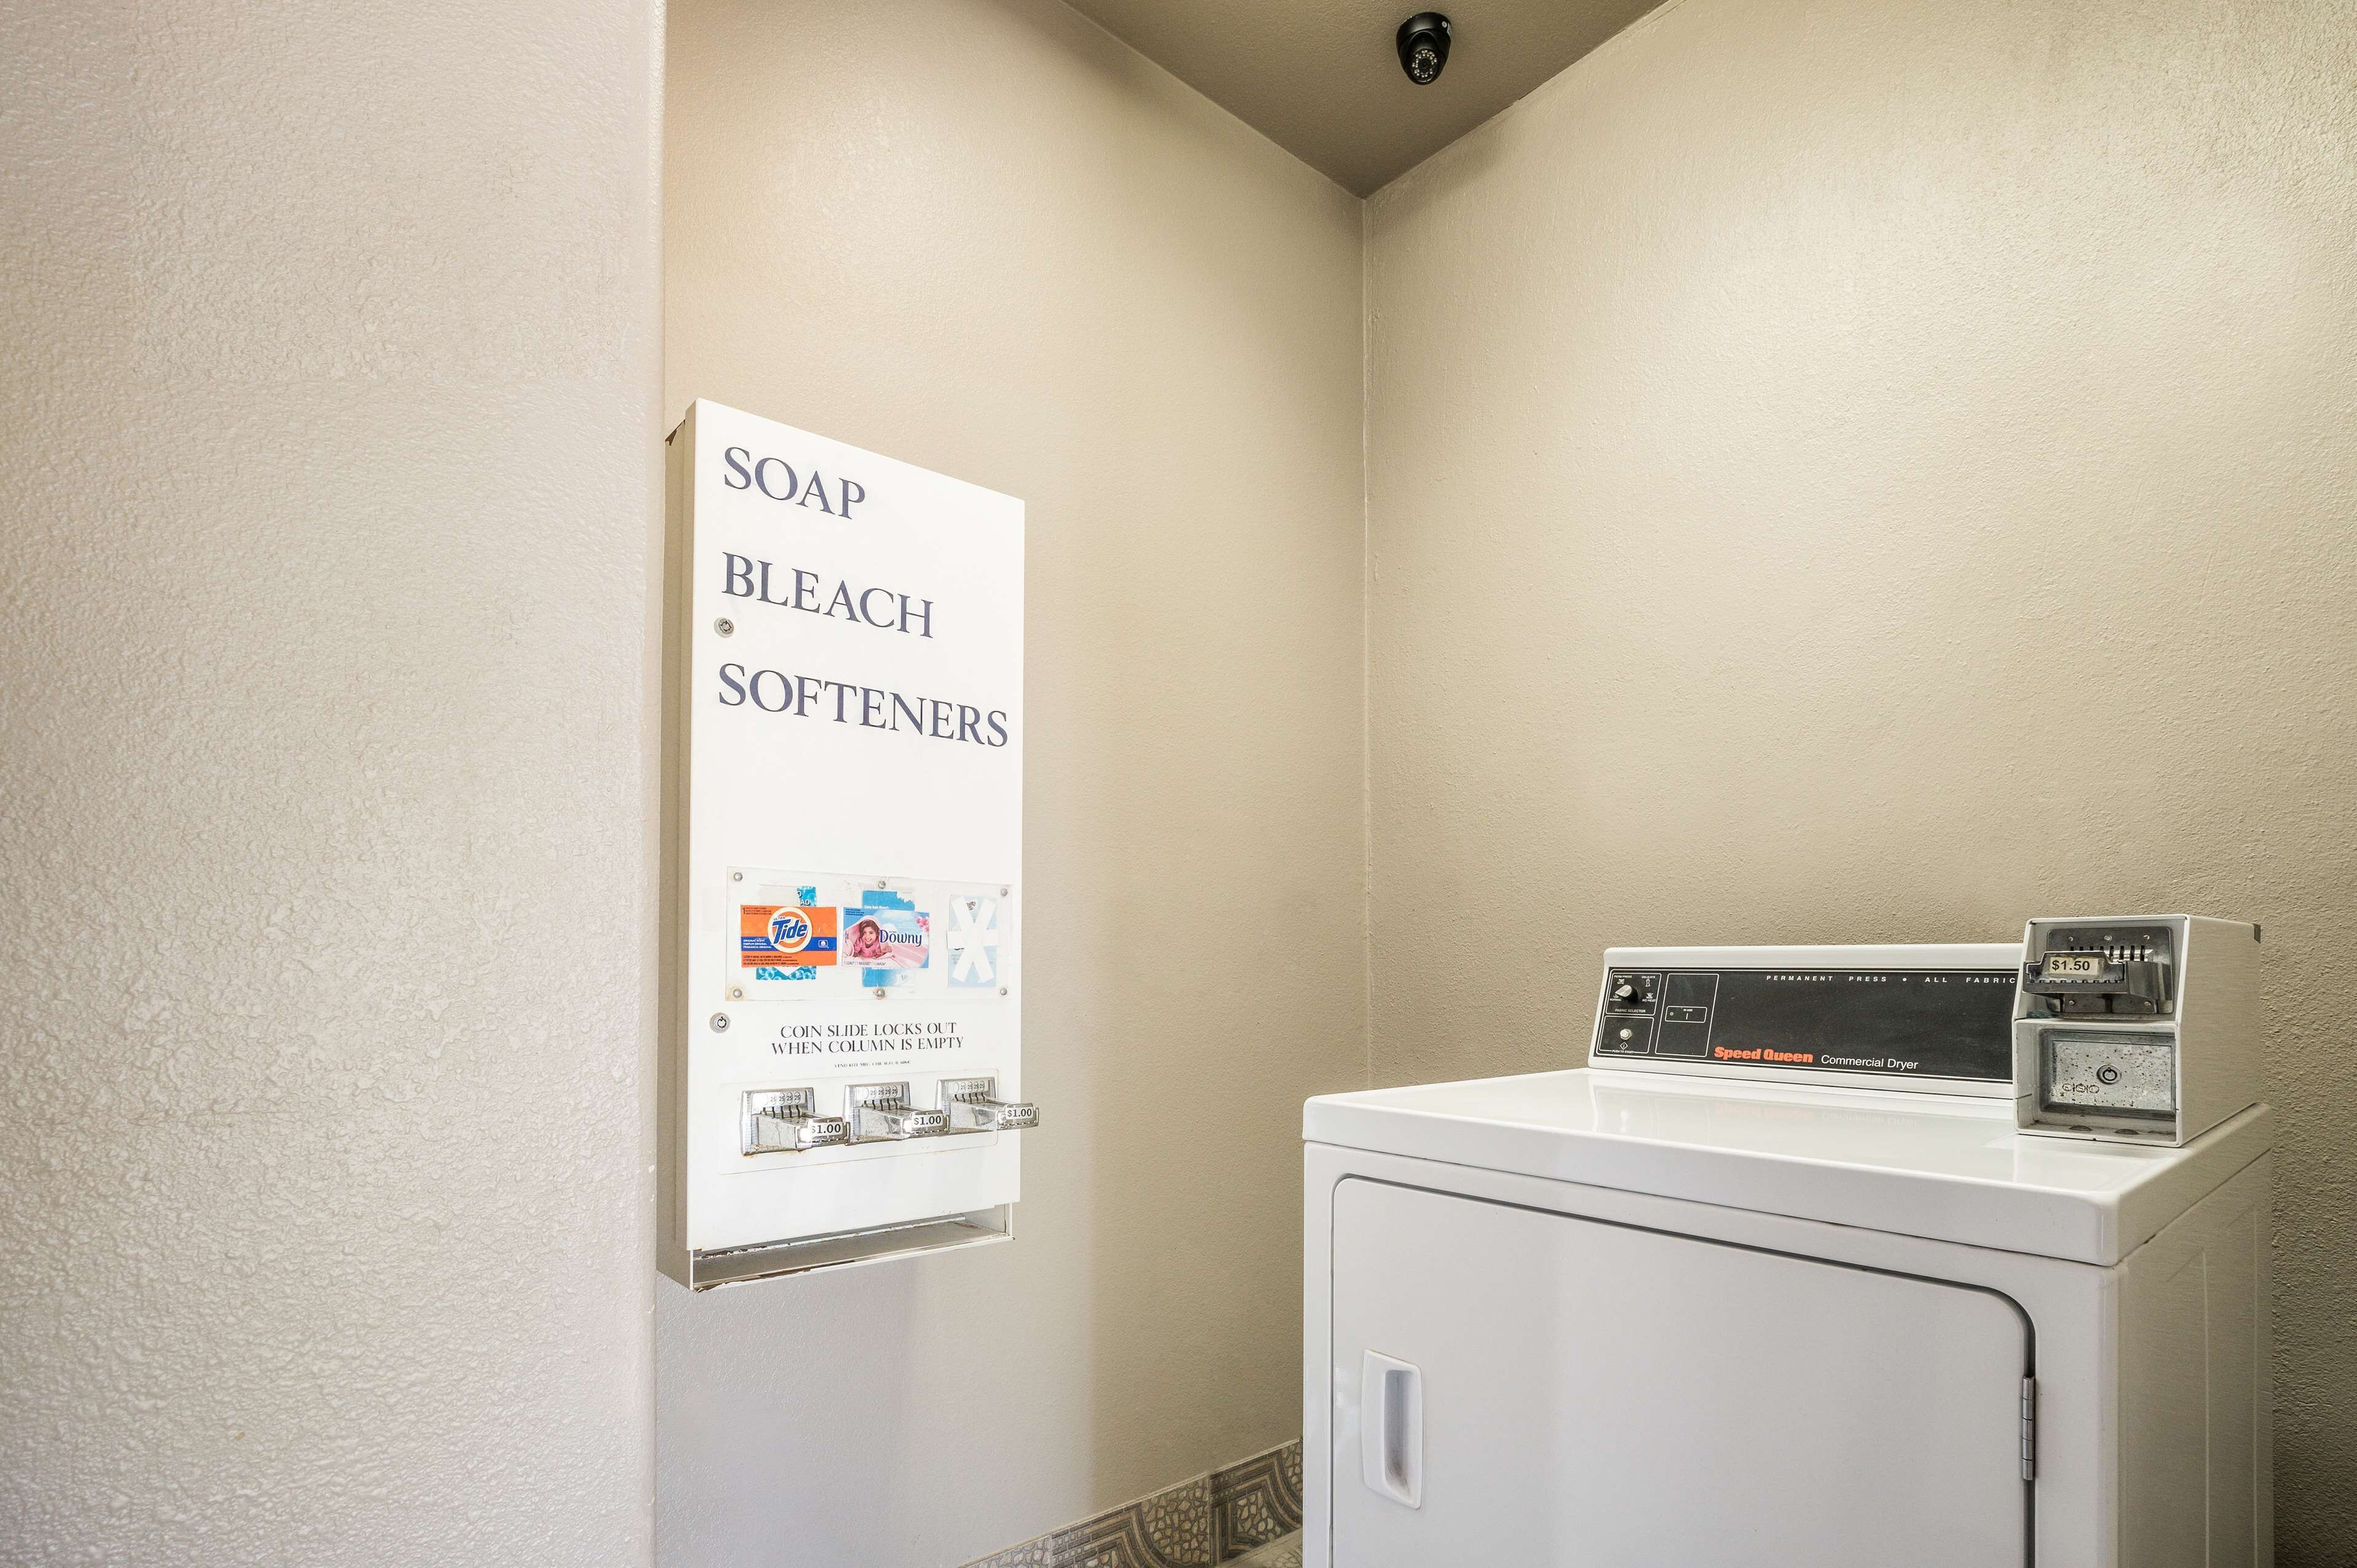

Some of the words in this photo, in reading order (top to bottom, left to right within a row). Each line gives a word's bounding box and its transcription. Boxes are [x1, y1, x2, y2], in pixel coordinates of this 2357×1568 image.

[723, 446, 866, 519] SOAP
[721, 551, 934, 638] BLEACH
[718, 662, 1009, 748] SOFTENERS
[772, 918, 808, 945] Tide
[879, 930, 922, 947] Downy
[2051, 960, 2091, 971] $1.50
[780, 1025, 822, 1039] COIN
[827, 1024, 868, 1037] SLIDE
[874, 1023, 922, 1036] LOCKS
[927, 1022, 957, 1034] OUT
[771, 1041, 822, 1054] WHEN
[829, 1039, 895, 1053] COLUMN
[901, 1038, 912, 1050] IS
[918, 1037, 963, 1049] EMPTY
[1714, 1046, 1761, 1060] Speed
[1763, 1048, 1814, 1063] Queen
[1821, 1055, 1884, 1068] Commercial
[1887, 1058, 1919, 1071] Dryer
[914, 1115, 942, 1125] $1.00
[1007, 1108, 1032, 1117] $1.00
[811, 1124, 841, 1134] $1.00
